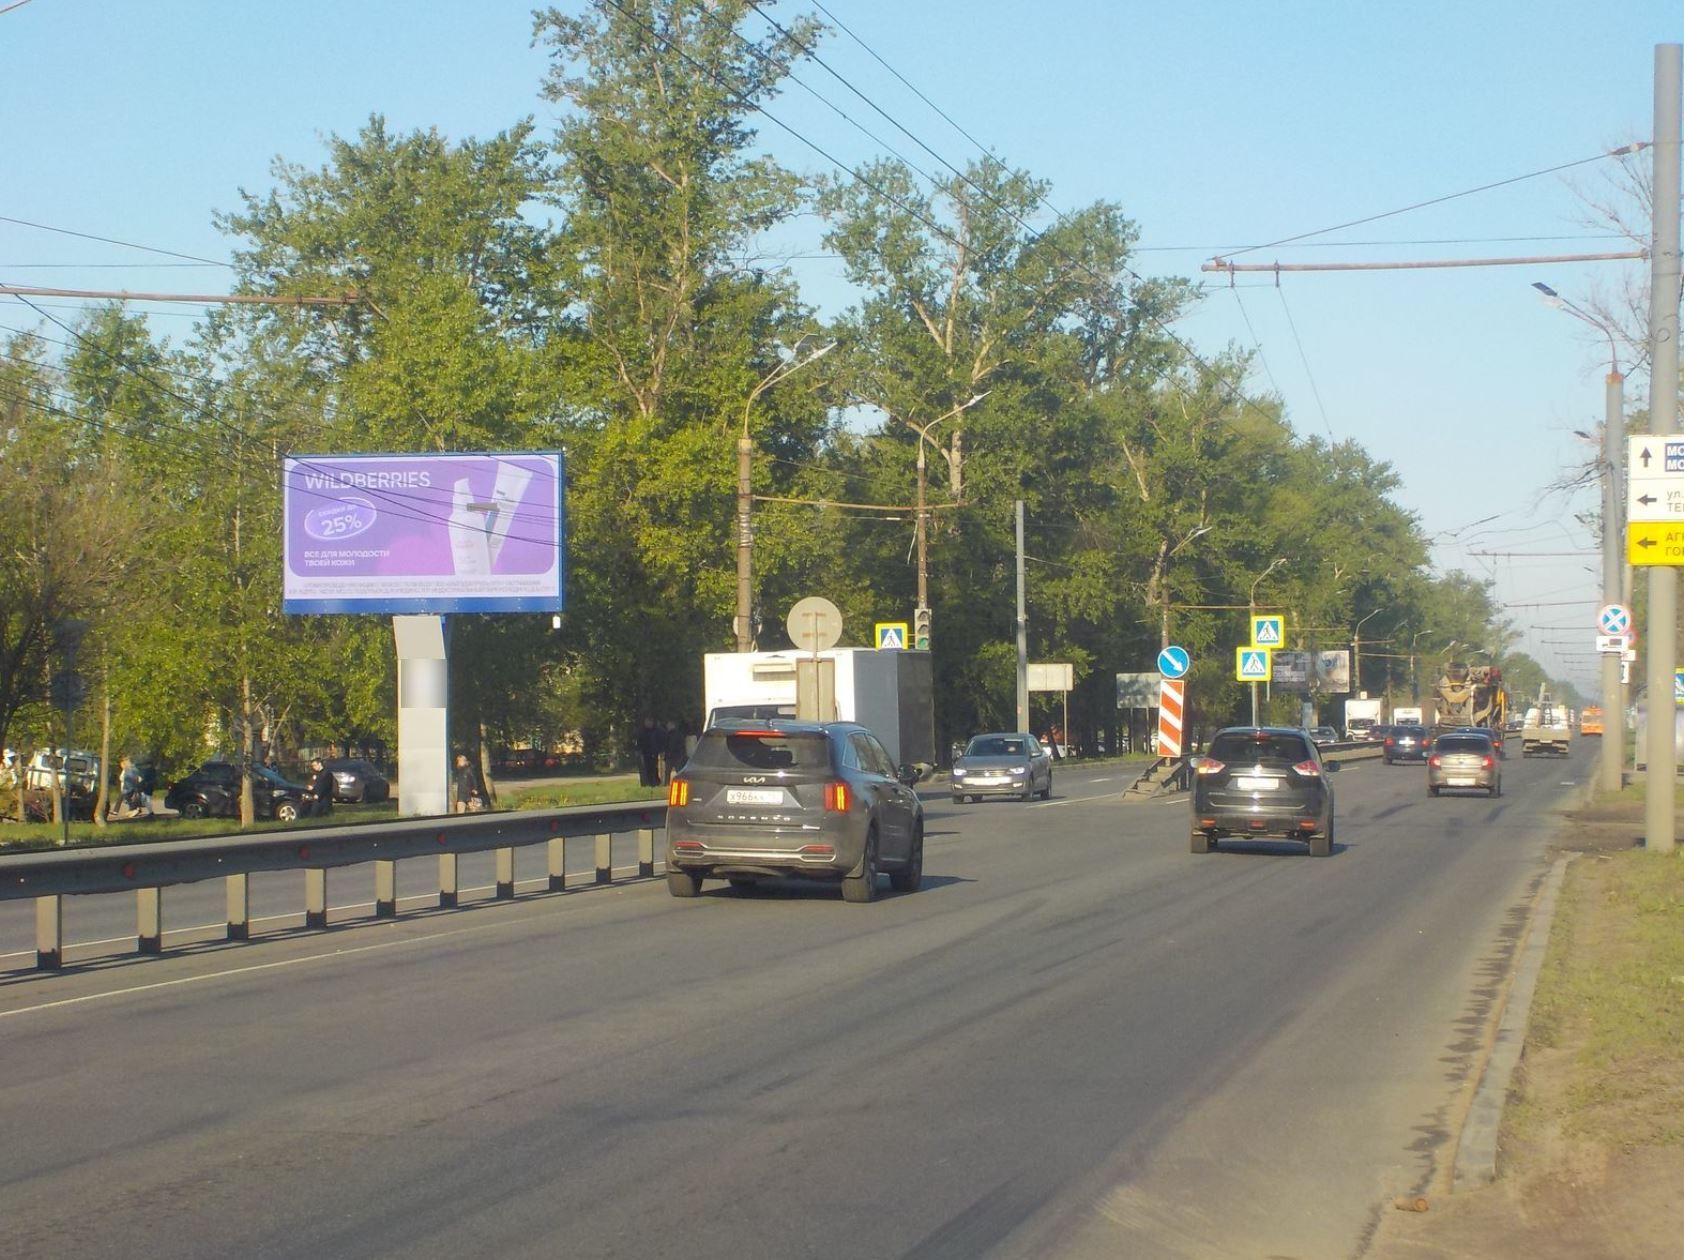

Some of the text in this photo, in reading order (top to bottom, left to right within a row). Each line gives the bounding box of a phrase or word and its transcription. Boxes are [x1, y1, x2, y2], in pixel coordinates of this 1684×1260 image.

[305, 472, 431, 489] WILDBERRIES
[1667, 502, 1684, 513] ТЕ
[321, 513, 362, 536] 25%
[1666, 532, 1684, 542] АГ
[321, 550, 338, 559] ДЛЯ
[339, 549, 390, 558] МОЛОДОСТИ
[1665, 546, 1684, 557] ГО
[304, 559, 355, 567] ТВОЕЙ КОЖИ
